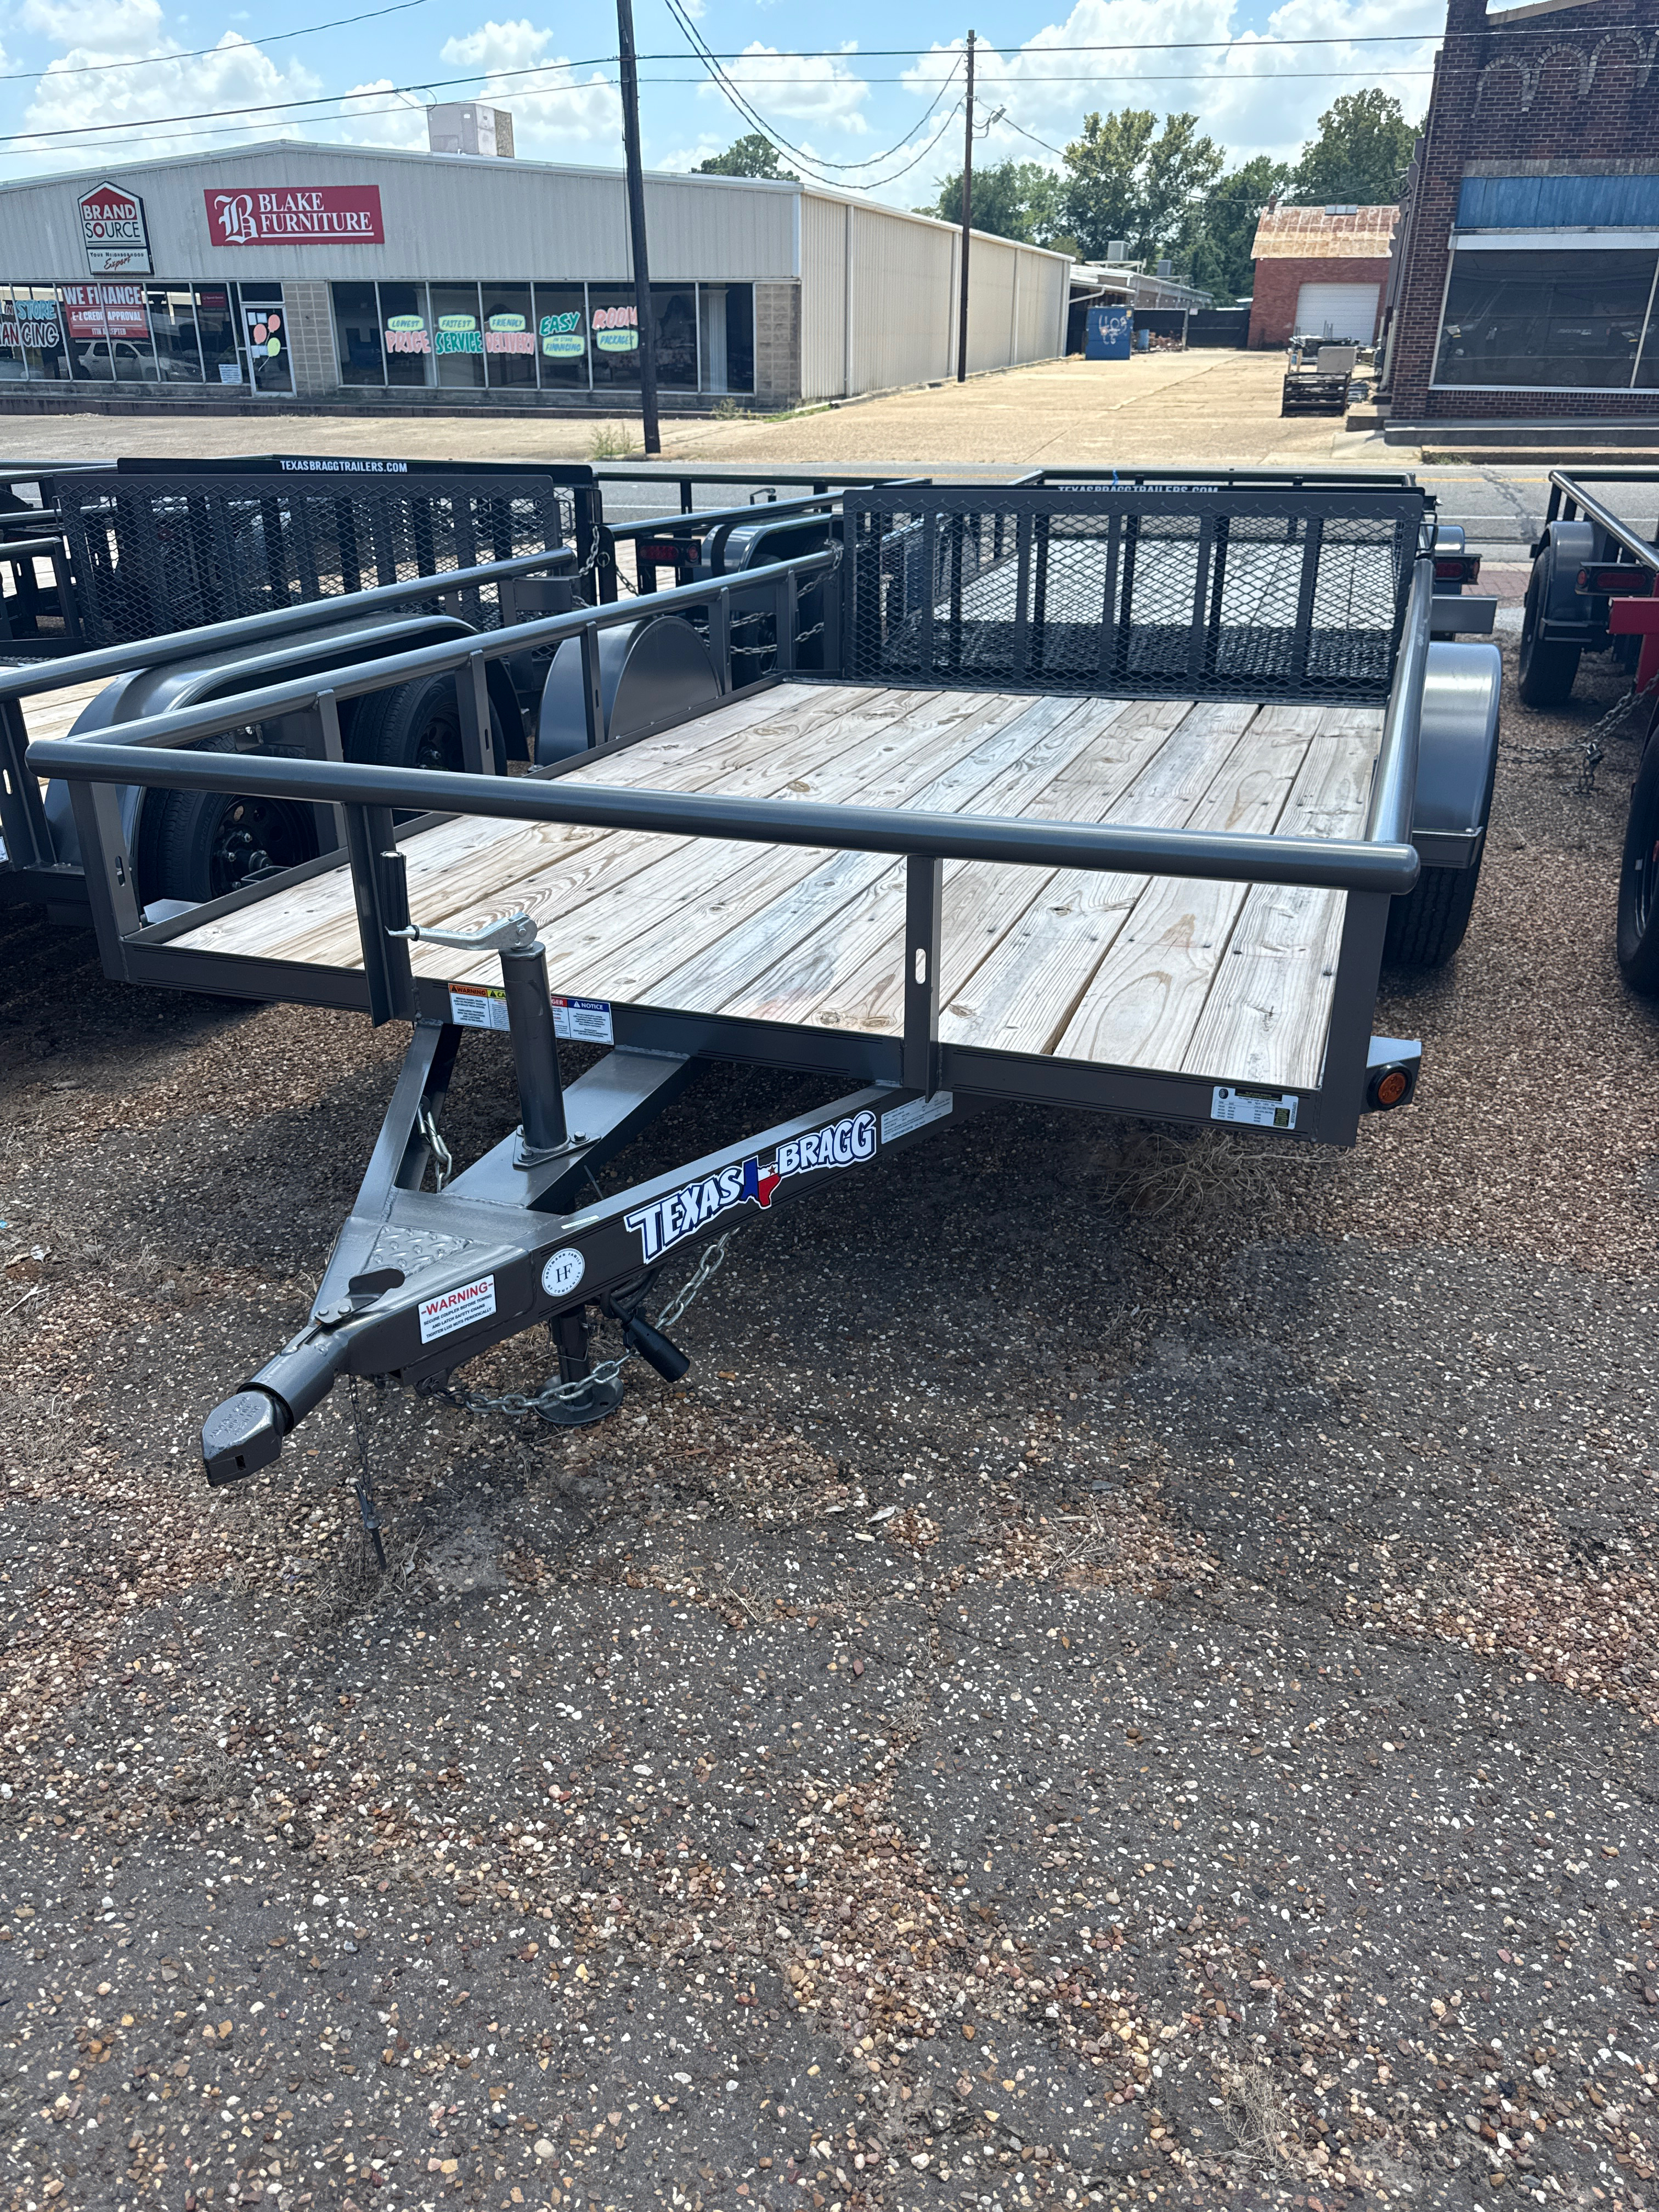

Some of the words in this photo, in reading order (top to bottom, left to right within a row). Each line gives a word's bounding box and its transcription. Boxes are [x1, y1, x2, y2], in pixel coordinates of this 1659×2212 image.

[83, 204, 136, 219] BRAND
[257, 192, 325, 212] BLAKE
[85, 222, 140, 238] SOURCE
[259, 212, 373, 232] FURNITURE
[104, 255, 131, 270] Expert
[62, 286, 85, 305] WE
[86, 286, 142, 305] FINANCE
[16, 300, 57, 320] STORE
[83, 311, 106, 321] CREDI
[107, 311, 142, 321] APPROVAL
[591, 306, 638, 330] ROOM
[391, 319, 421, 328] LOWEST
[442, 319, 472, 328] FASTEST
[539, 311, 581, 337] EASY
[0, 321, 60, 348] ANCING
[385, 330, 431, 354] PRICE
[435, 330, 484, 355] SERVICE
[486, 332, 536, 356] DELIVERY
[280, 460, 408, 473] TEXASBRAGGTRAILERS.COM
[456, 987, 486, 996] WARNING
[625, 1165, 743, 1262] TEXAS
[776, 1111, 876, 1176] BRAGG
[568, 1252, 582, 1265] FAMILY
[554, 1272, 581, 1293] COMPANIES
[555, 1263, 573, 1283] HF
[424, 1316, 440, 1326] SECURE
[441, 1307, 460, 1318] COUPLER
[460, 1300, 476, 1310] BEFORE
[426, 1328, 444, 1338] TIGHTEN
[453, 1319, 464, 1327] NUTS
[464, 1307, 492, 1322] PERIODICALLY
[441, 1317, 454, 1325] LATCH
[470, 1304, 485, 1313] CHAINS
